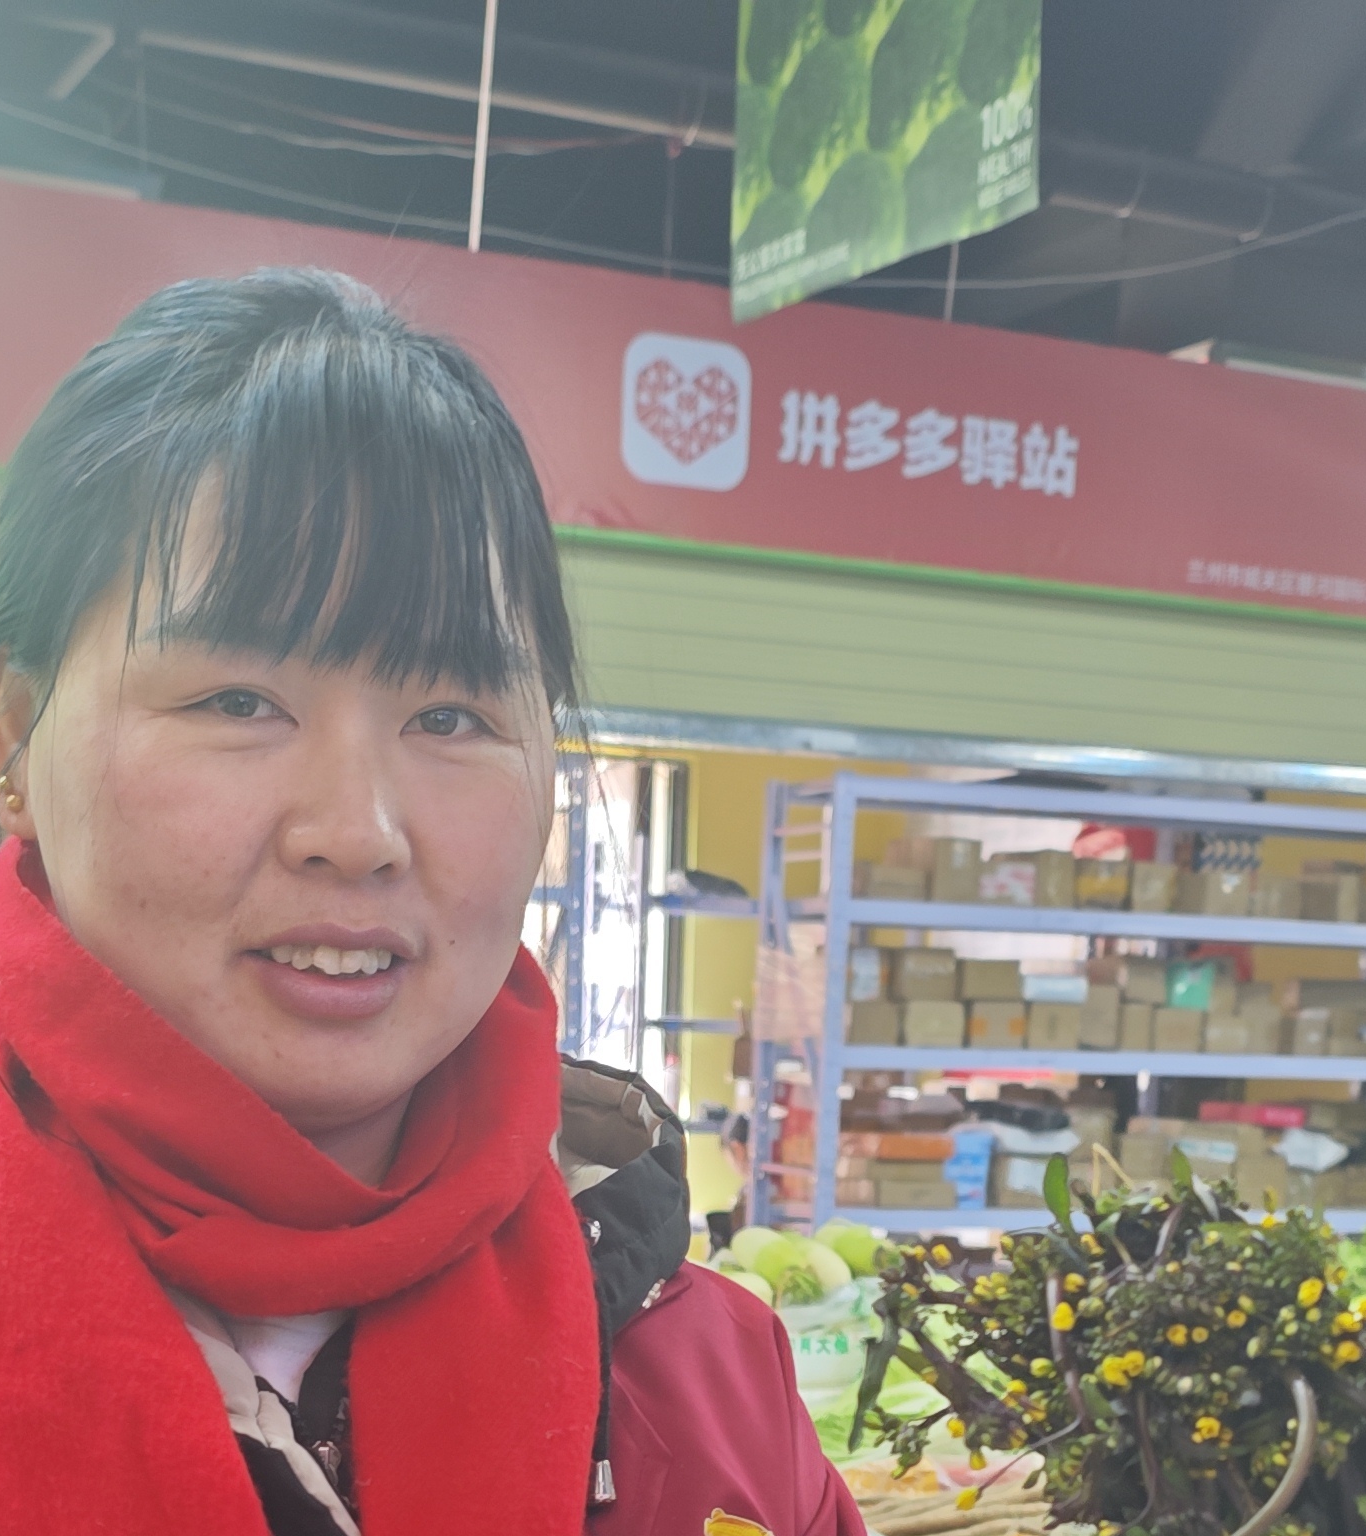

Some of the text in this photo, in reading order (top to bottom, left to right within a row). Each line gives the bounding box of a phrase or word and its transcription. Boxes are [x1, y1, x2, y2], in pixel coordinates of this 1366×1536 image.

[777, 388, 1080, 499] 拼多多驿站
